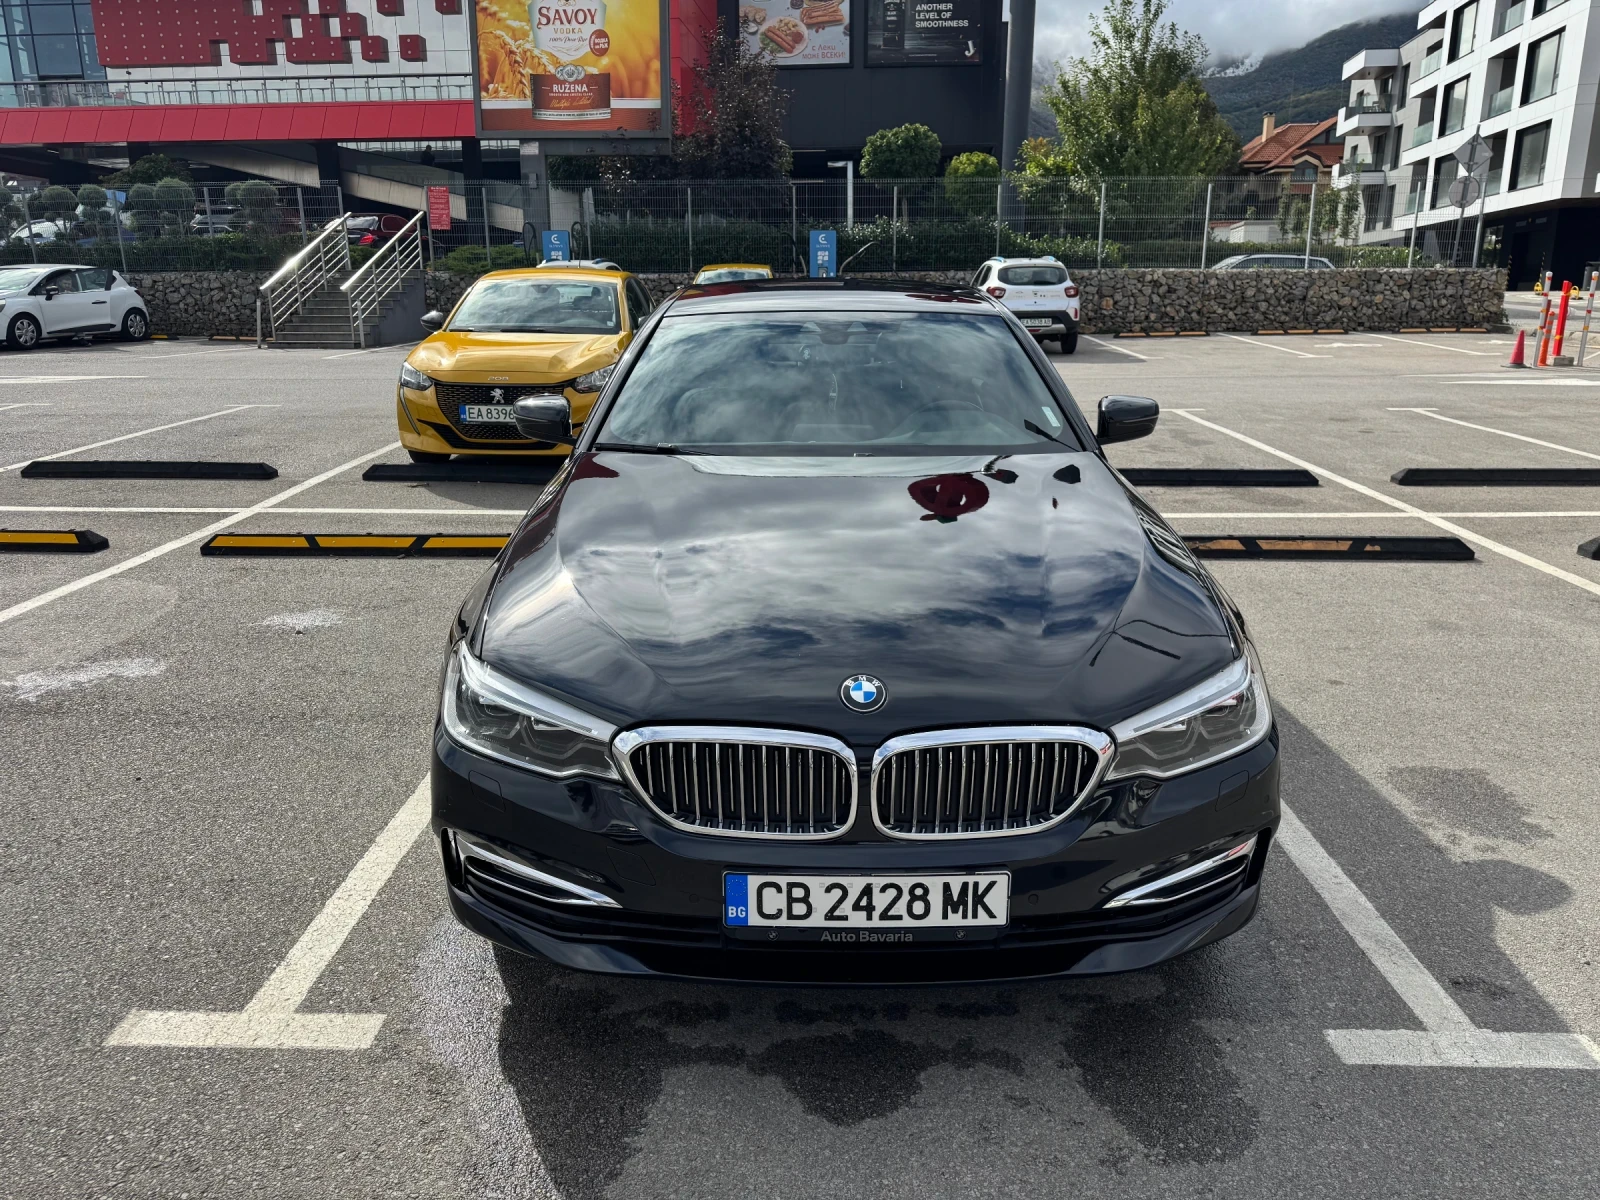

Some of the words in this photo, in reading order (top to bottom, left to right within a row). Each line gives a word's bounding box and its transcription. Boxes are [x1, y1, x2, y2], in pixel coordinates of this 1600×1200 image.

[915, 3, 953, 11] ANOTHER
[536, 6, 598, 29] SAVOY
[915, 20, 969, 28] SMOOTHNESS
[821, 51, 846, 59] ВСЕКИ!
[552, 83, 588, 93] RUŽENA
[467, 407, 484, 420] EA
[845, 675, 881, 687] BMW
[756, 881, 813, 920] CB
[823, 882, 931, 921] 2428
[941, 880, 998, 920] MK
[728, 906, 746, 918] BG
[820, 931, 856, 942] Auto
[859, 931, 913, 942] Bavaria
